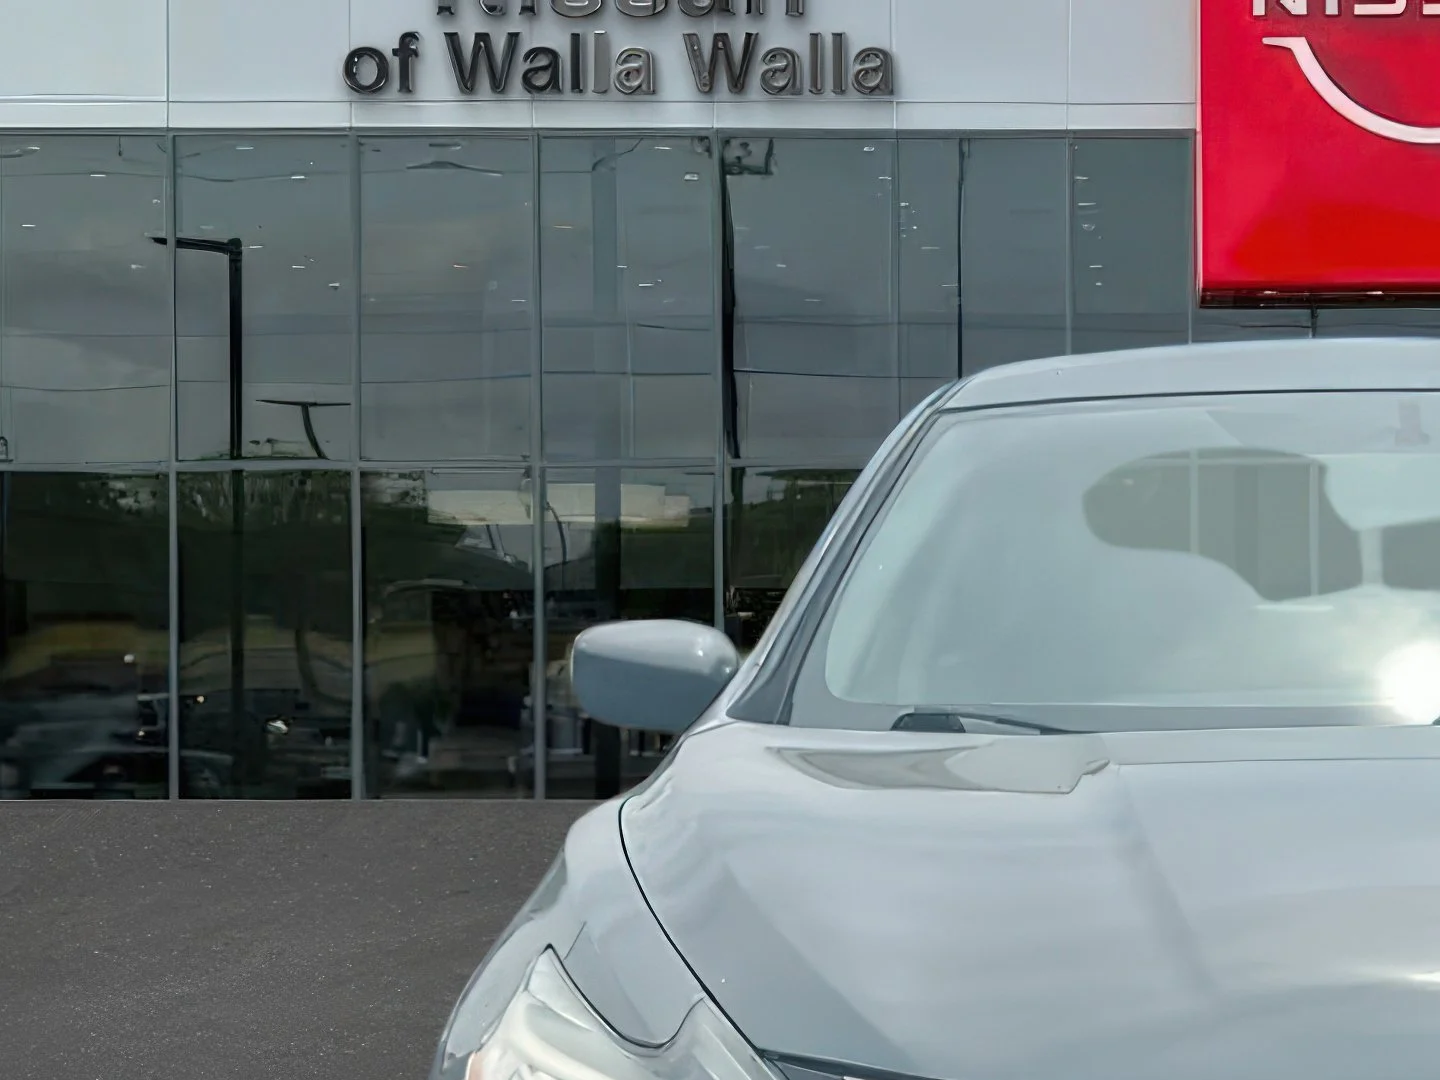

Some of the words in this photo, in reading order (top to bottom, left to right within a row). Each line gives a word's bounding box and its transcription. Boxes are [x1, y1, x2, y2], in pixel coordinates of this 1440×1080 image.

[342, 31, 421, 94] of
[444, 31, 656, 95] Walla
[682, 31, 894, 95] Walla
